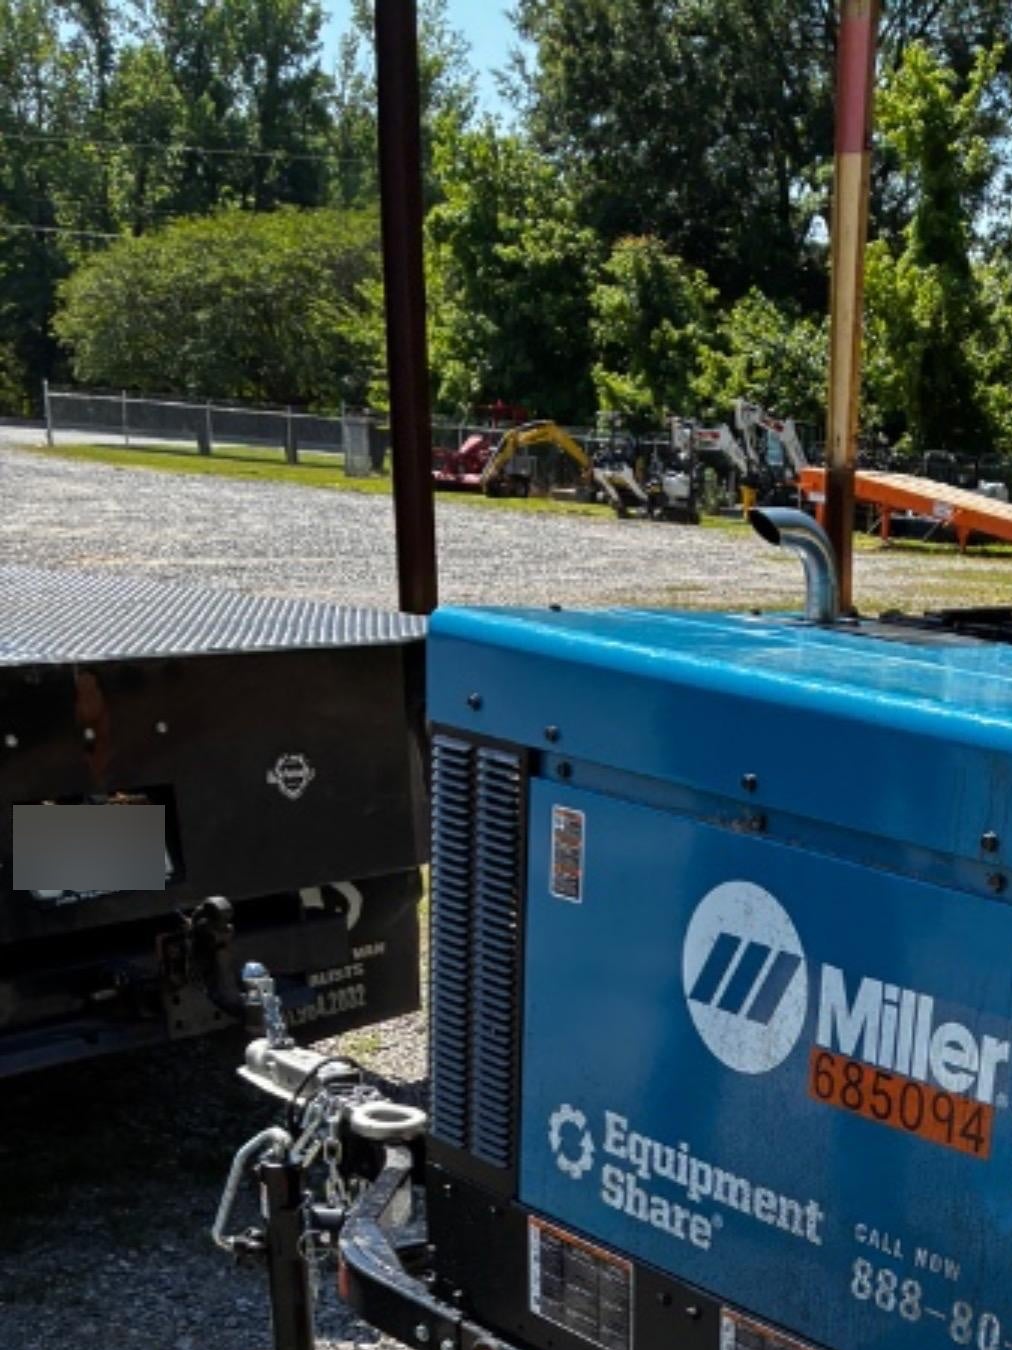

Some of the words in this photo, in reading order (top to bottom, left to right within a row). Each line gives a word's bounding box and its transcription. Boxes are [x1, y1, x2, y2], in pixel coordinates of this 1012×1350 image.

[816, 962, 1010, 1104] Miller
[813, 1052, 986, 1153] 685094
[603, 1109, 825, 1246] Equipment
[854, 1223, 904, 1259] CALL
[914, 1247, 962, 1282] NOW
